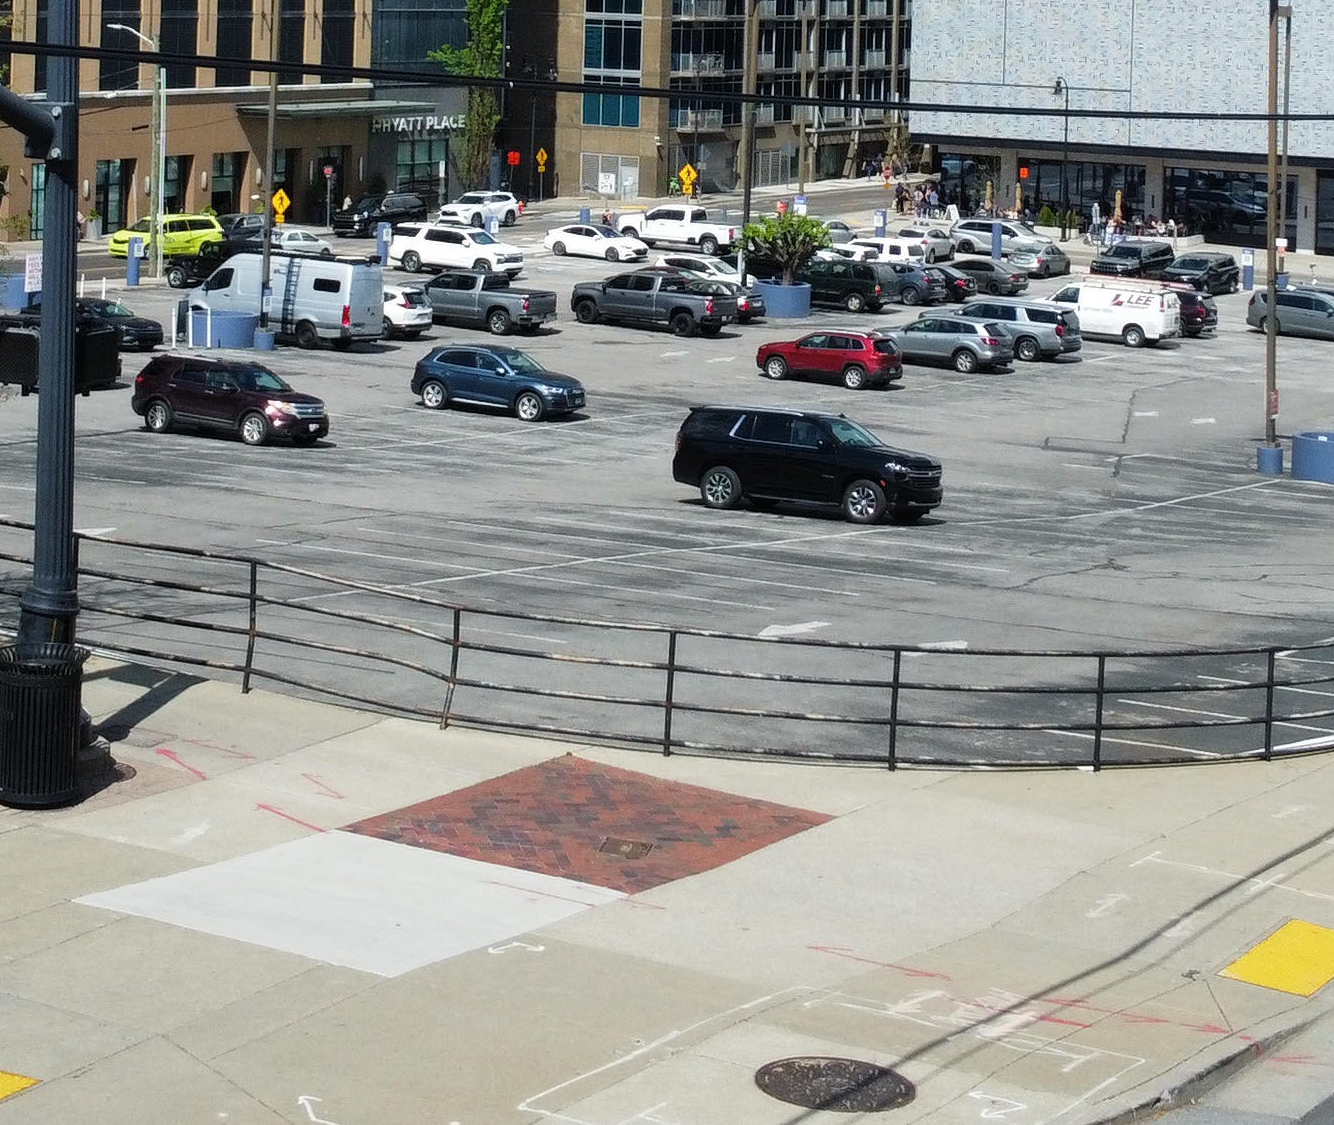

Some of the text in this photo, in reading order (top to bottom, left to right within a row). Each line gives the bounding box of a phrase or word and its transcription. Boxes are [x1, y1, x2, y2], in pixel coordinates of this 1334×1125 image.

[382, 114, 466, 132] HYATT PLACE
[1126, 294, 1156, 306] LEE
